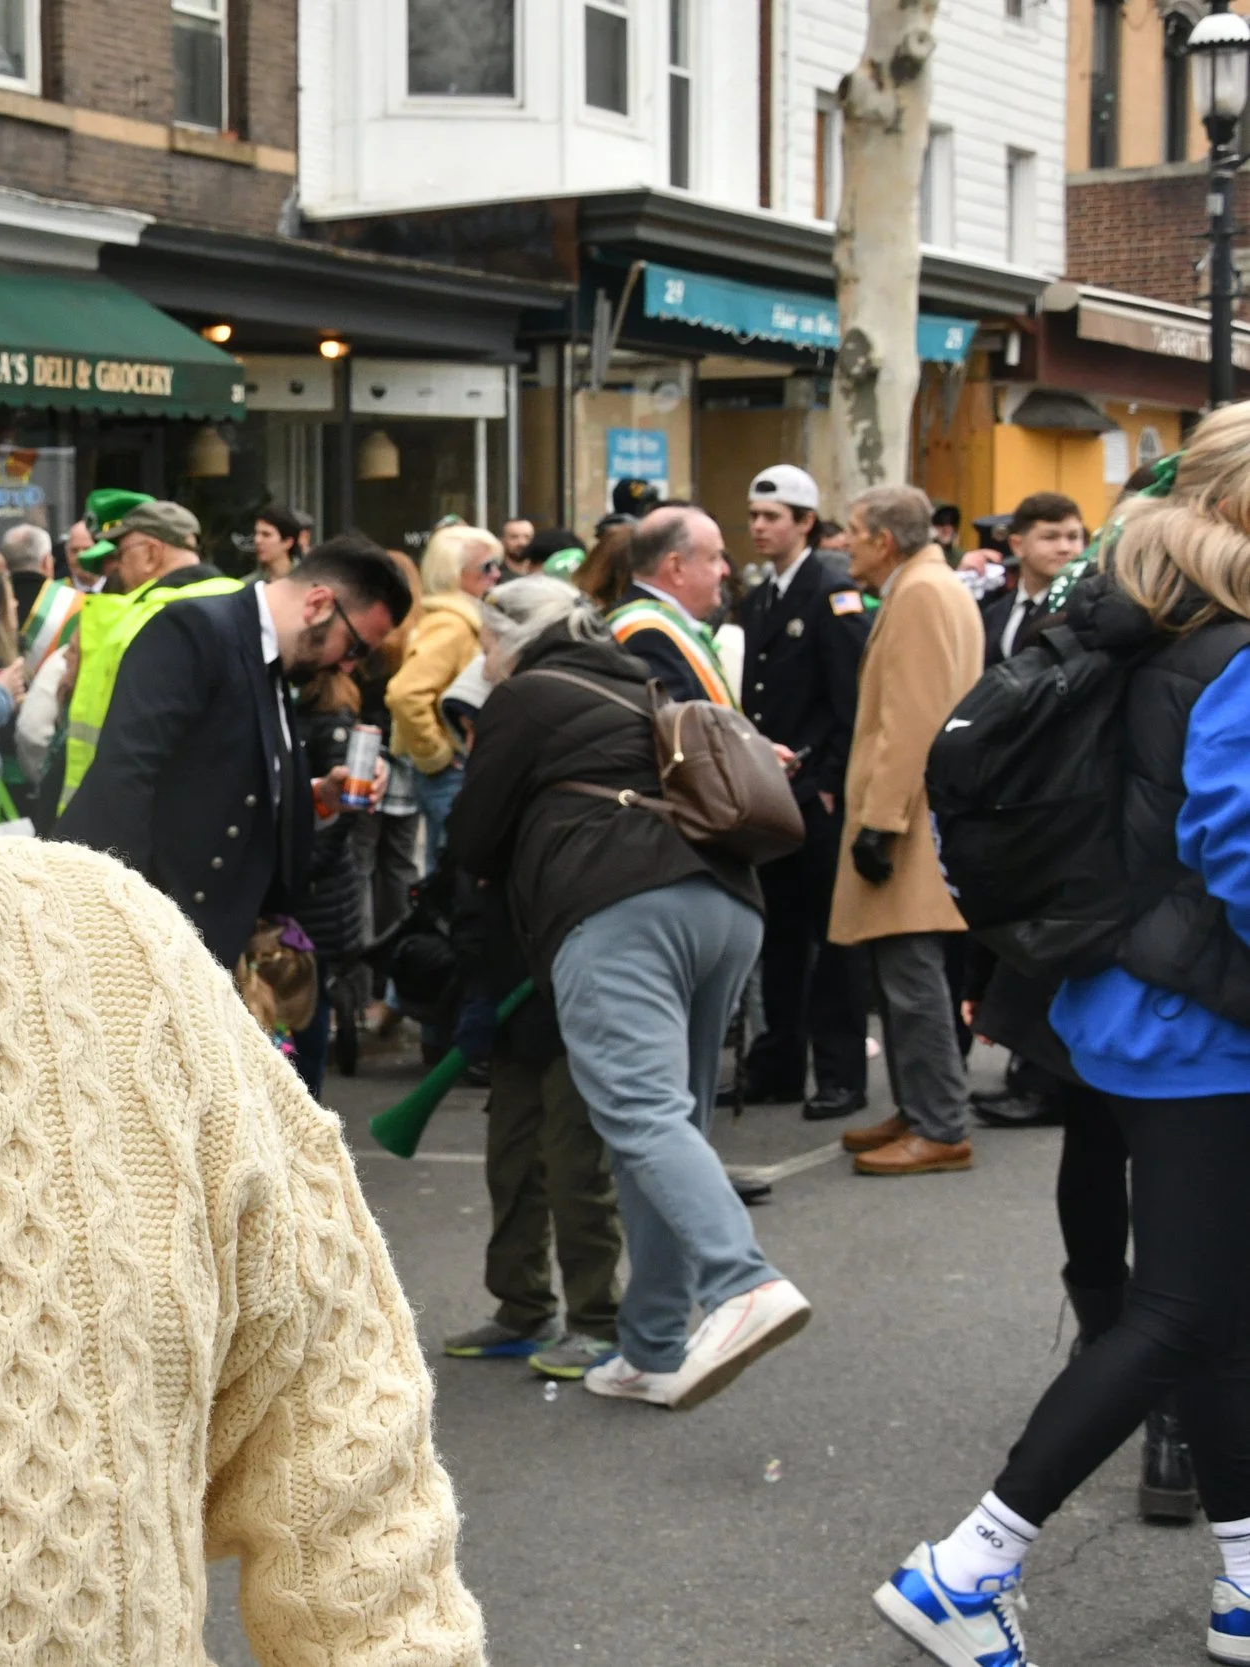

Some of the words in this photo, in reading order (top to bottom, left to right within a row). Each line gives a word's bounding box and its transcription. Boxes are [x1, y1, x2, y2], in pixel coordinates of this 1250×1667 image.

[33, 355, 72, 388] DELI
[75, 359, 91, 389] &
[96, 361, 174, 396] GROCERY
[976, 1525, 1003, 1548] alo
